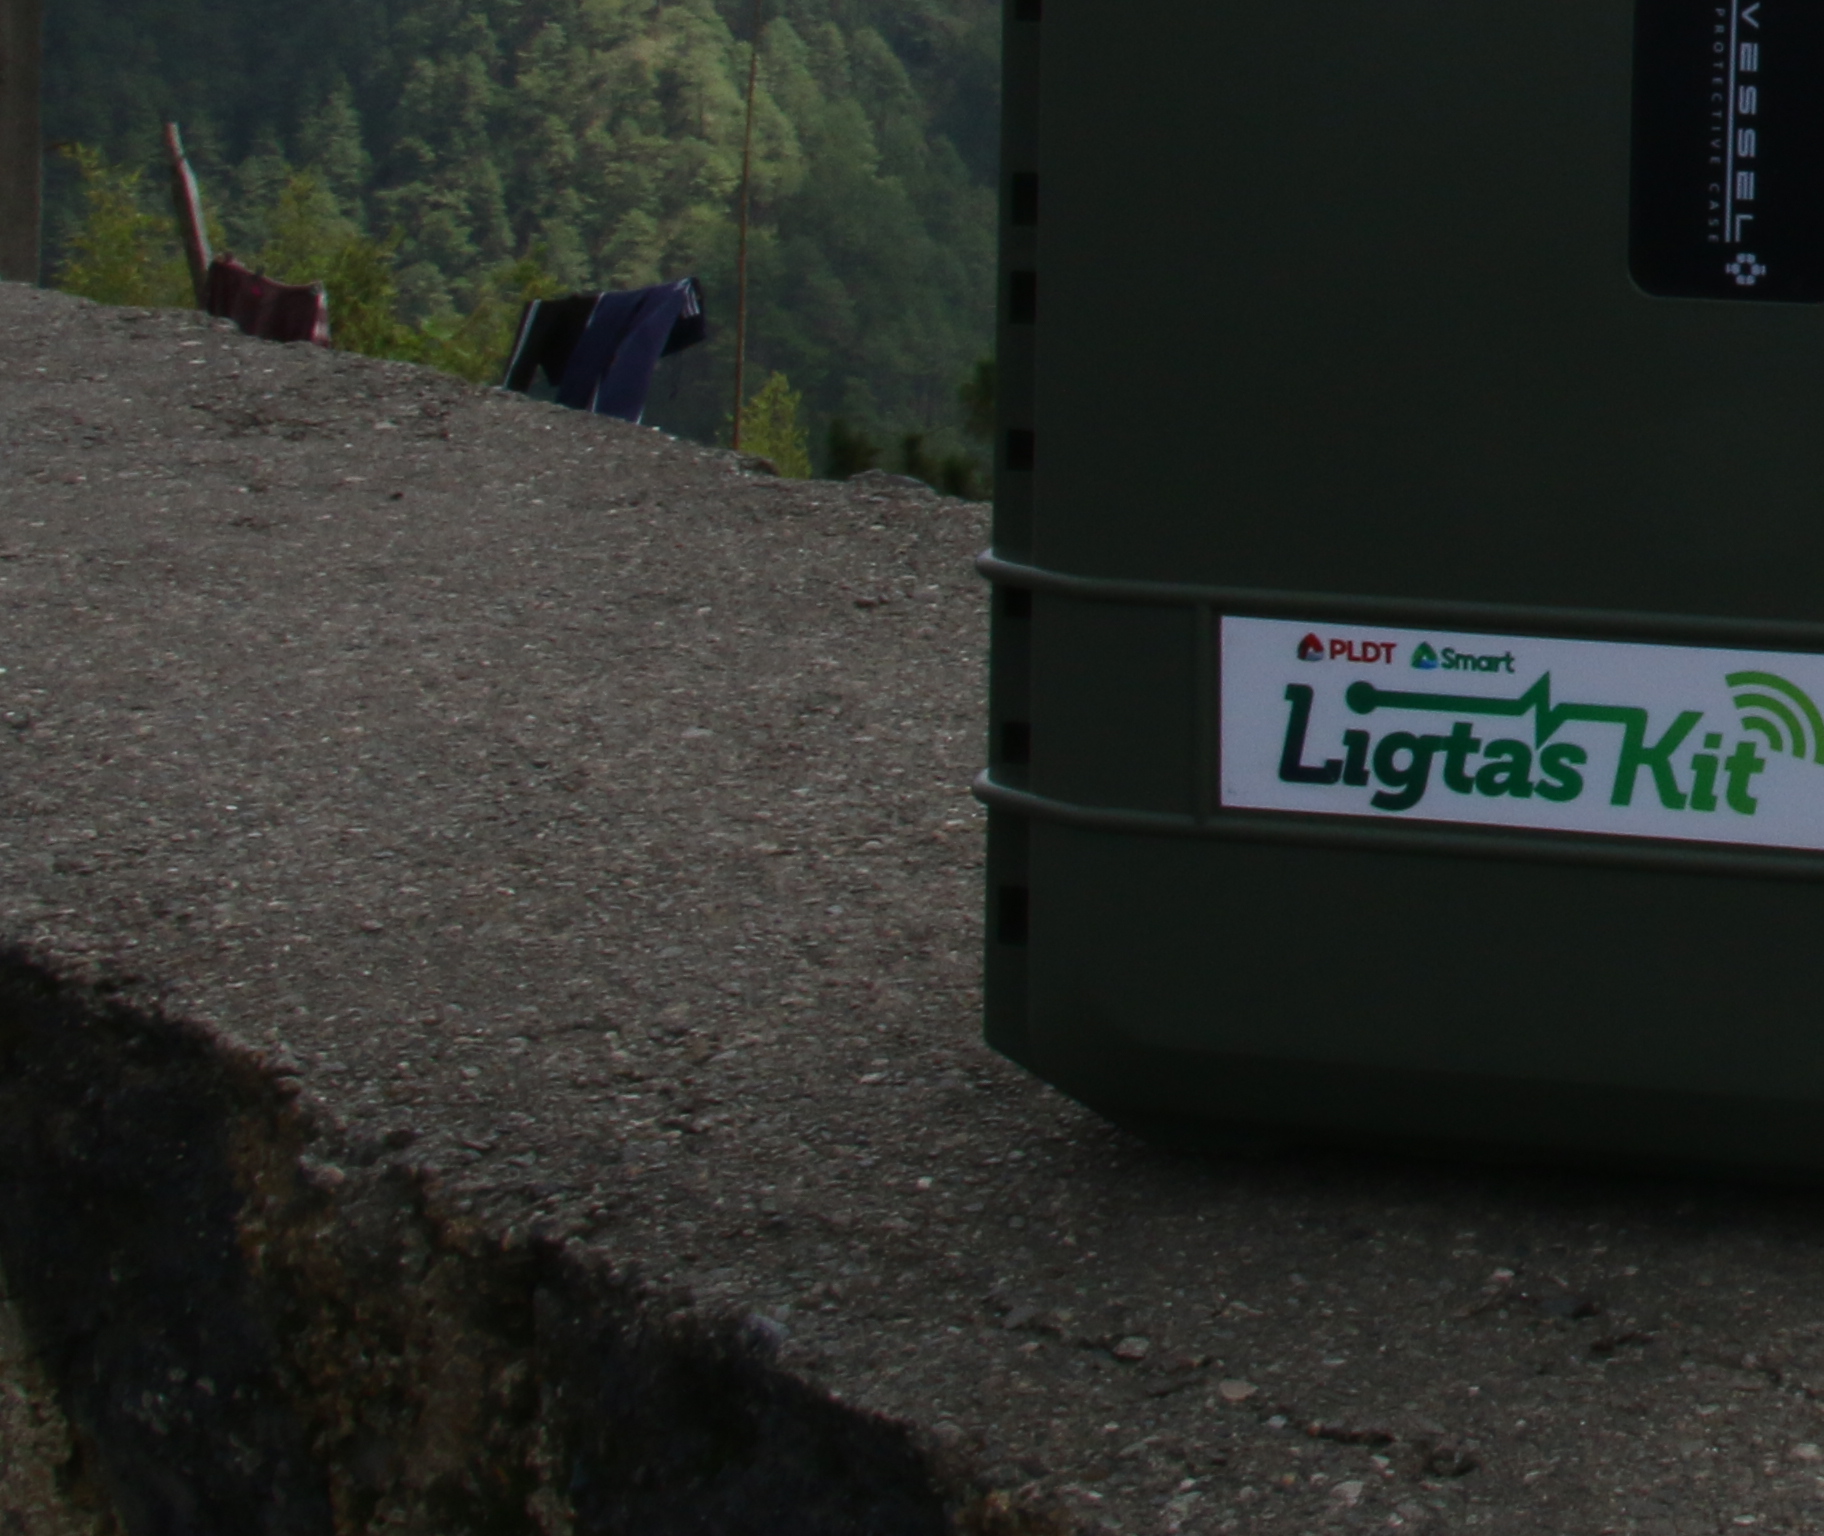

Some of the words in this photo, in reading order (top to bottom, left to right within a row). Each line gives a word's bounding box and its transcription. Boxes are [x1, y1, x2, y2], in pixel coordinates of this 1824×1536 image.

[1710, 7, 1725, 164] PROTECTIVE
[1735, 2, 1760, 243] VESSEL
[1708, 182, 1721, 243] CASE
[1329, 638, 1397, 665] PLDT
[1440, 647, 1516, 674] Smart
[1277, 682, 1588, 812] Ligtas
[1609, 707, 1766, 816] Kit
